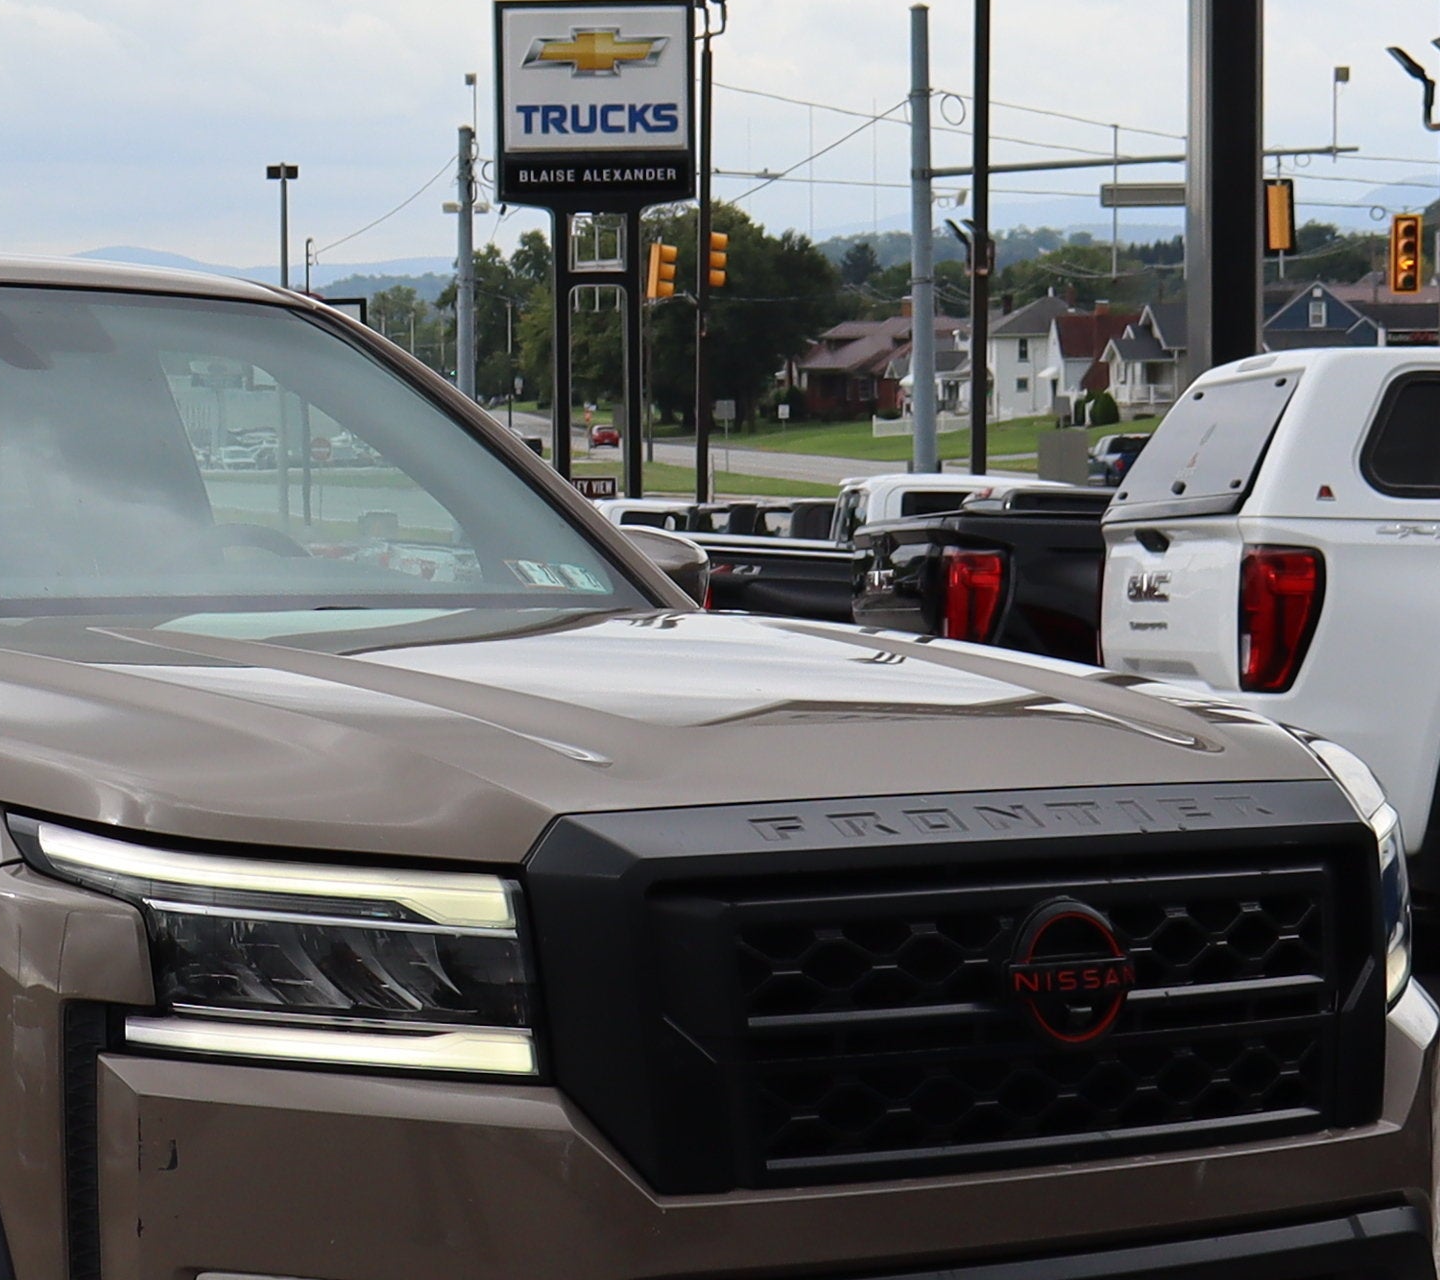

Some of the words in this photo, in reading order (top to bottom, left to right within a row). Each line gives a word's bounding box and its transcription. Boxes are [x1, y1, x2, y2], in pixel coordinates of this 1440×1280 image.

[515, 103, 679, 135] TRUCKS
[519, 169, 576, 183] BLAISE
[583, 168, 677, 182] ALEXANDER
[591, 480, 613, 494] VIEW
[747, 795, 1275, 842] FRONTIER
[1012, 964, 1137, 993] NISSAN
